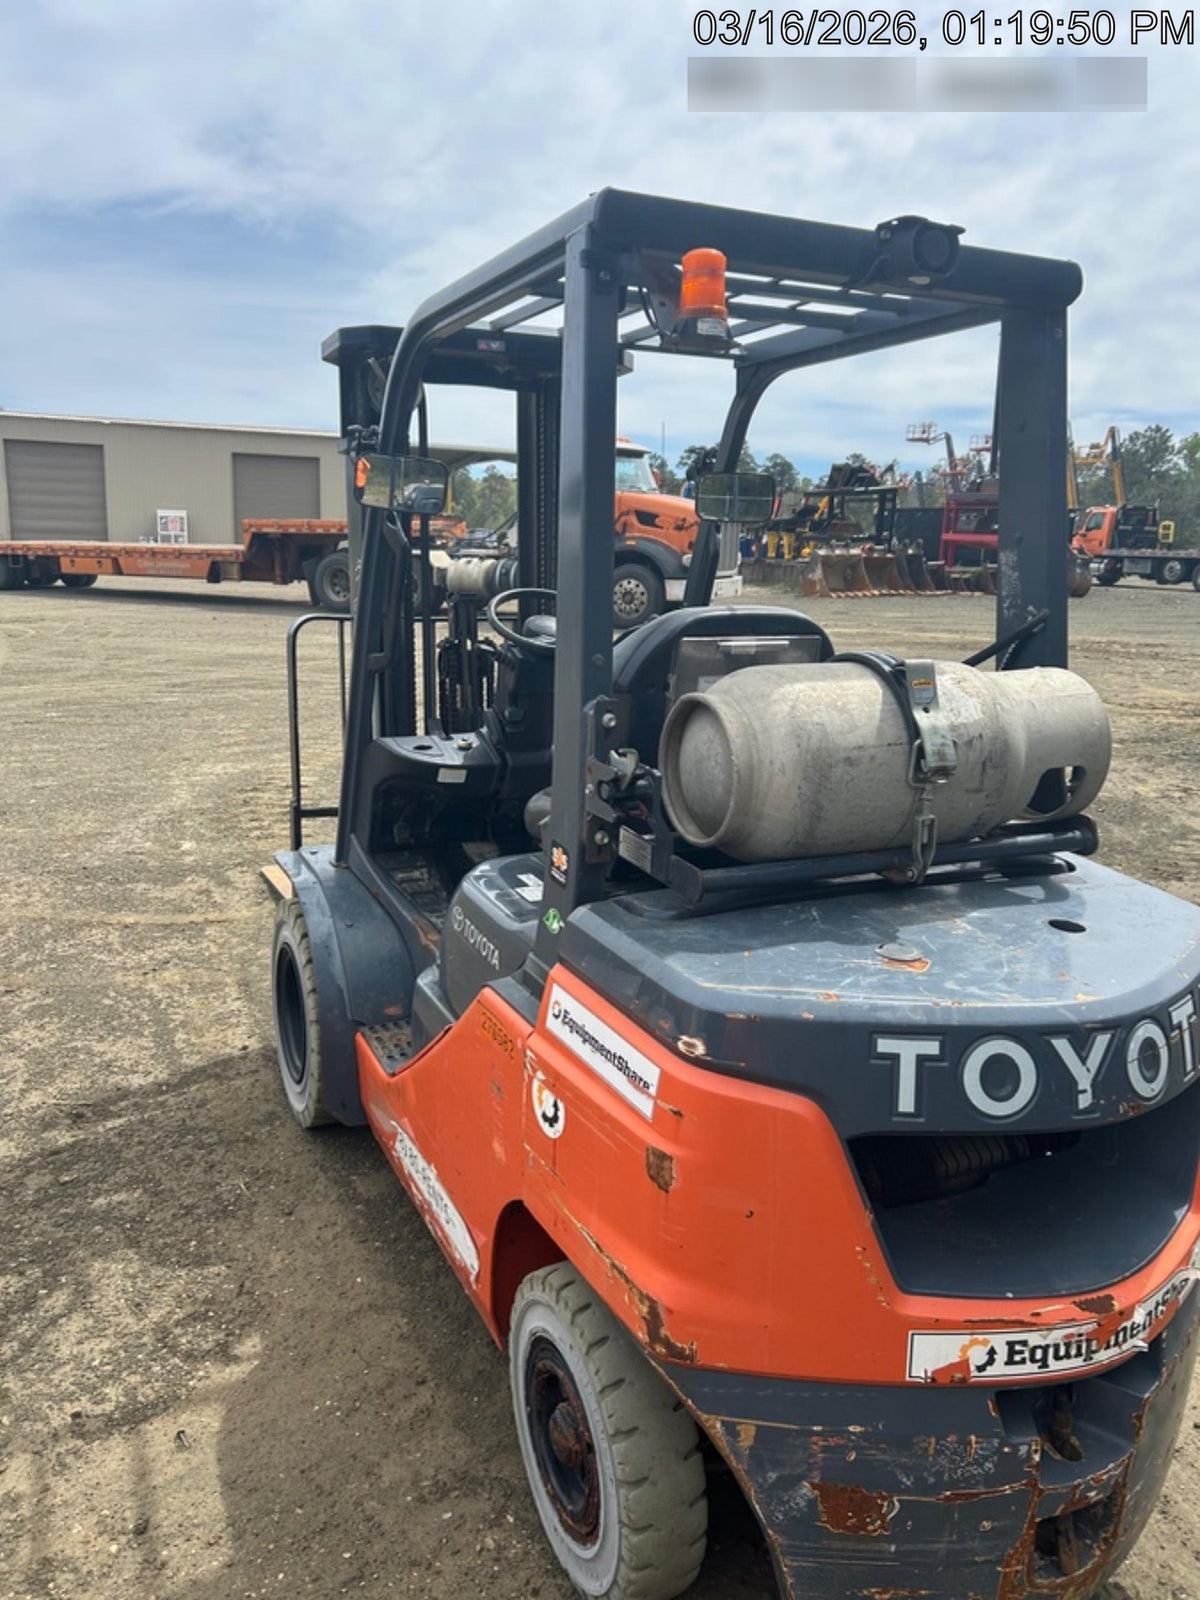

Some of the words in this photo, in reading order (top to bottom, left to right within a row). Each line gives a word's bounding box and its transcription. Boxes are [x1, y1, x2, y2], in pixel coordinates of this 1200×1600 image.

[463, 918, 500, 971] TOYOTA
[561, 1008, 651, 1091] EquipmentShare
[874, 984, 1200, 1117] TOYOT
